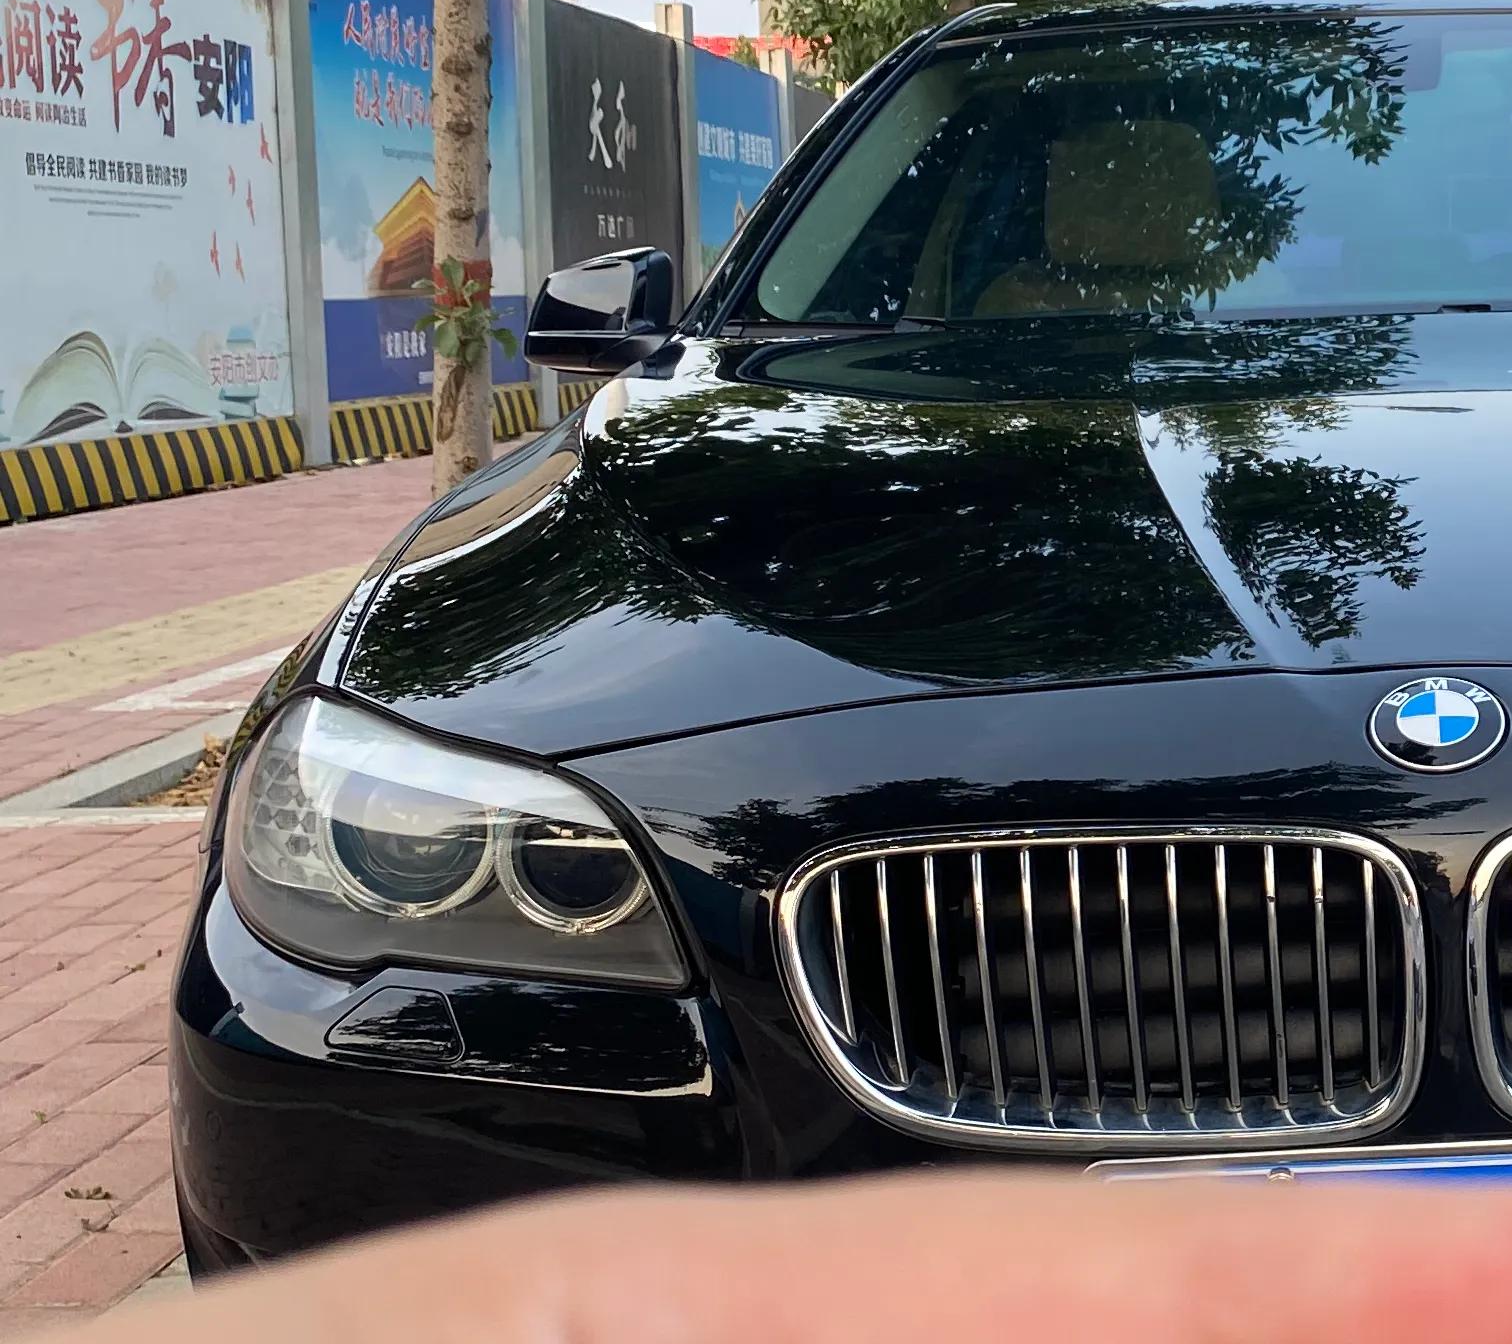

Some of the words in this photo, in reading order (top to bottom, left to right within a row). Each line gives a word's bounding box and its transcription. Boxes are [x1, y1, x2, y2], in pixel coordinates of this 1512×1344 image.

[193, 34, 255, 125] 安阳
[355, 68, 434, 135] 就是我们的
[25, 152, 86, 179] 倡导全民阅读
[89, 159, 144, 185] 共建书香家园
[145, 164, 188, 188] 我的读书梦
[1384, 678, 1492, 707] BMW
